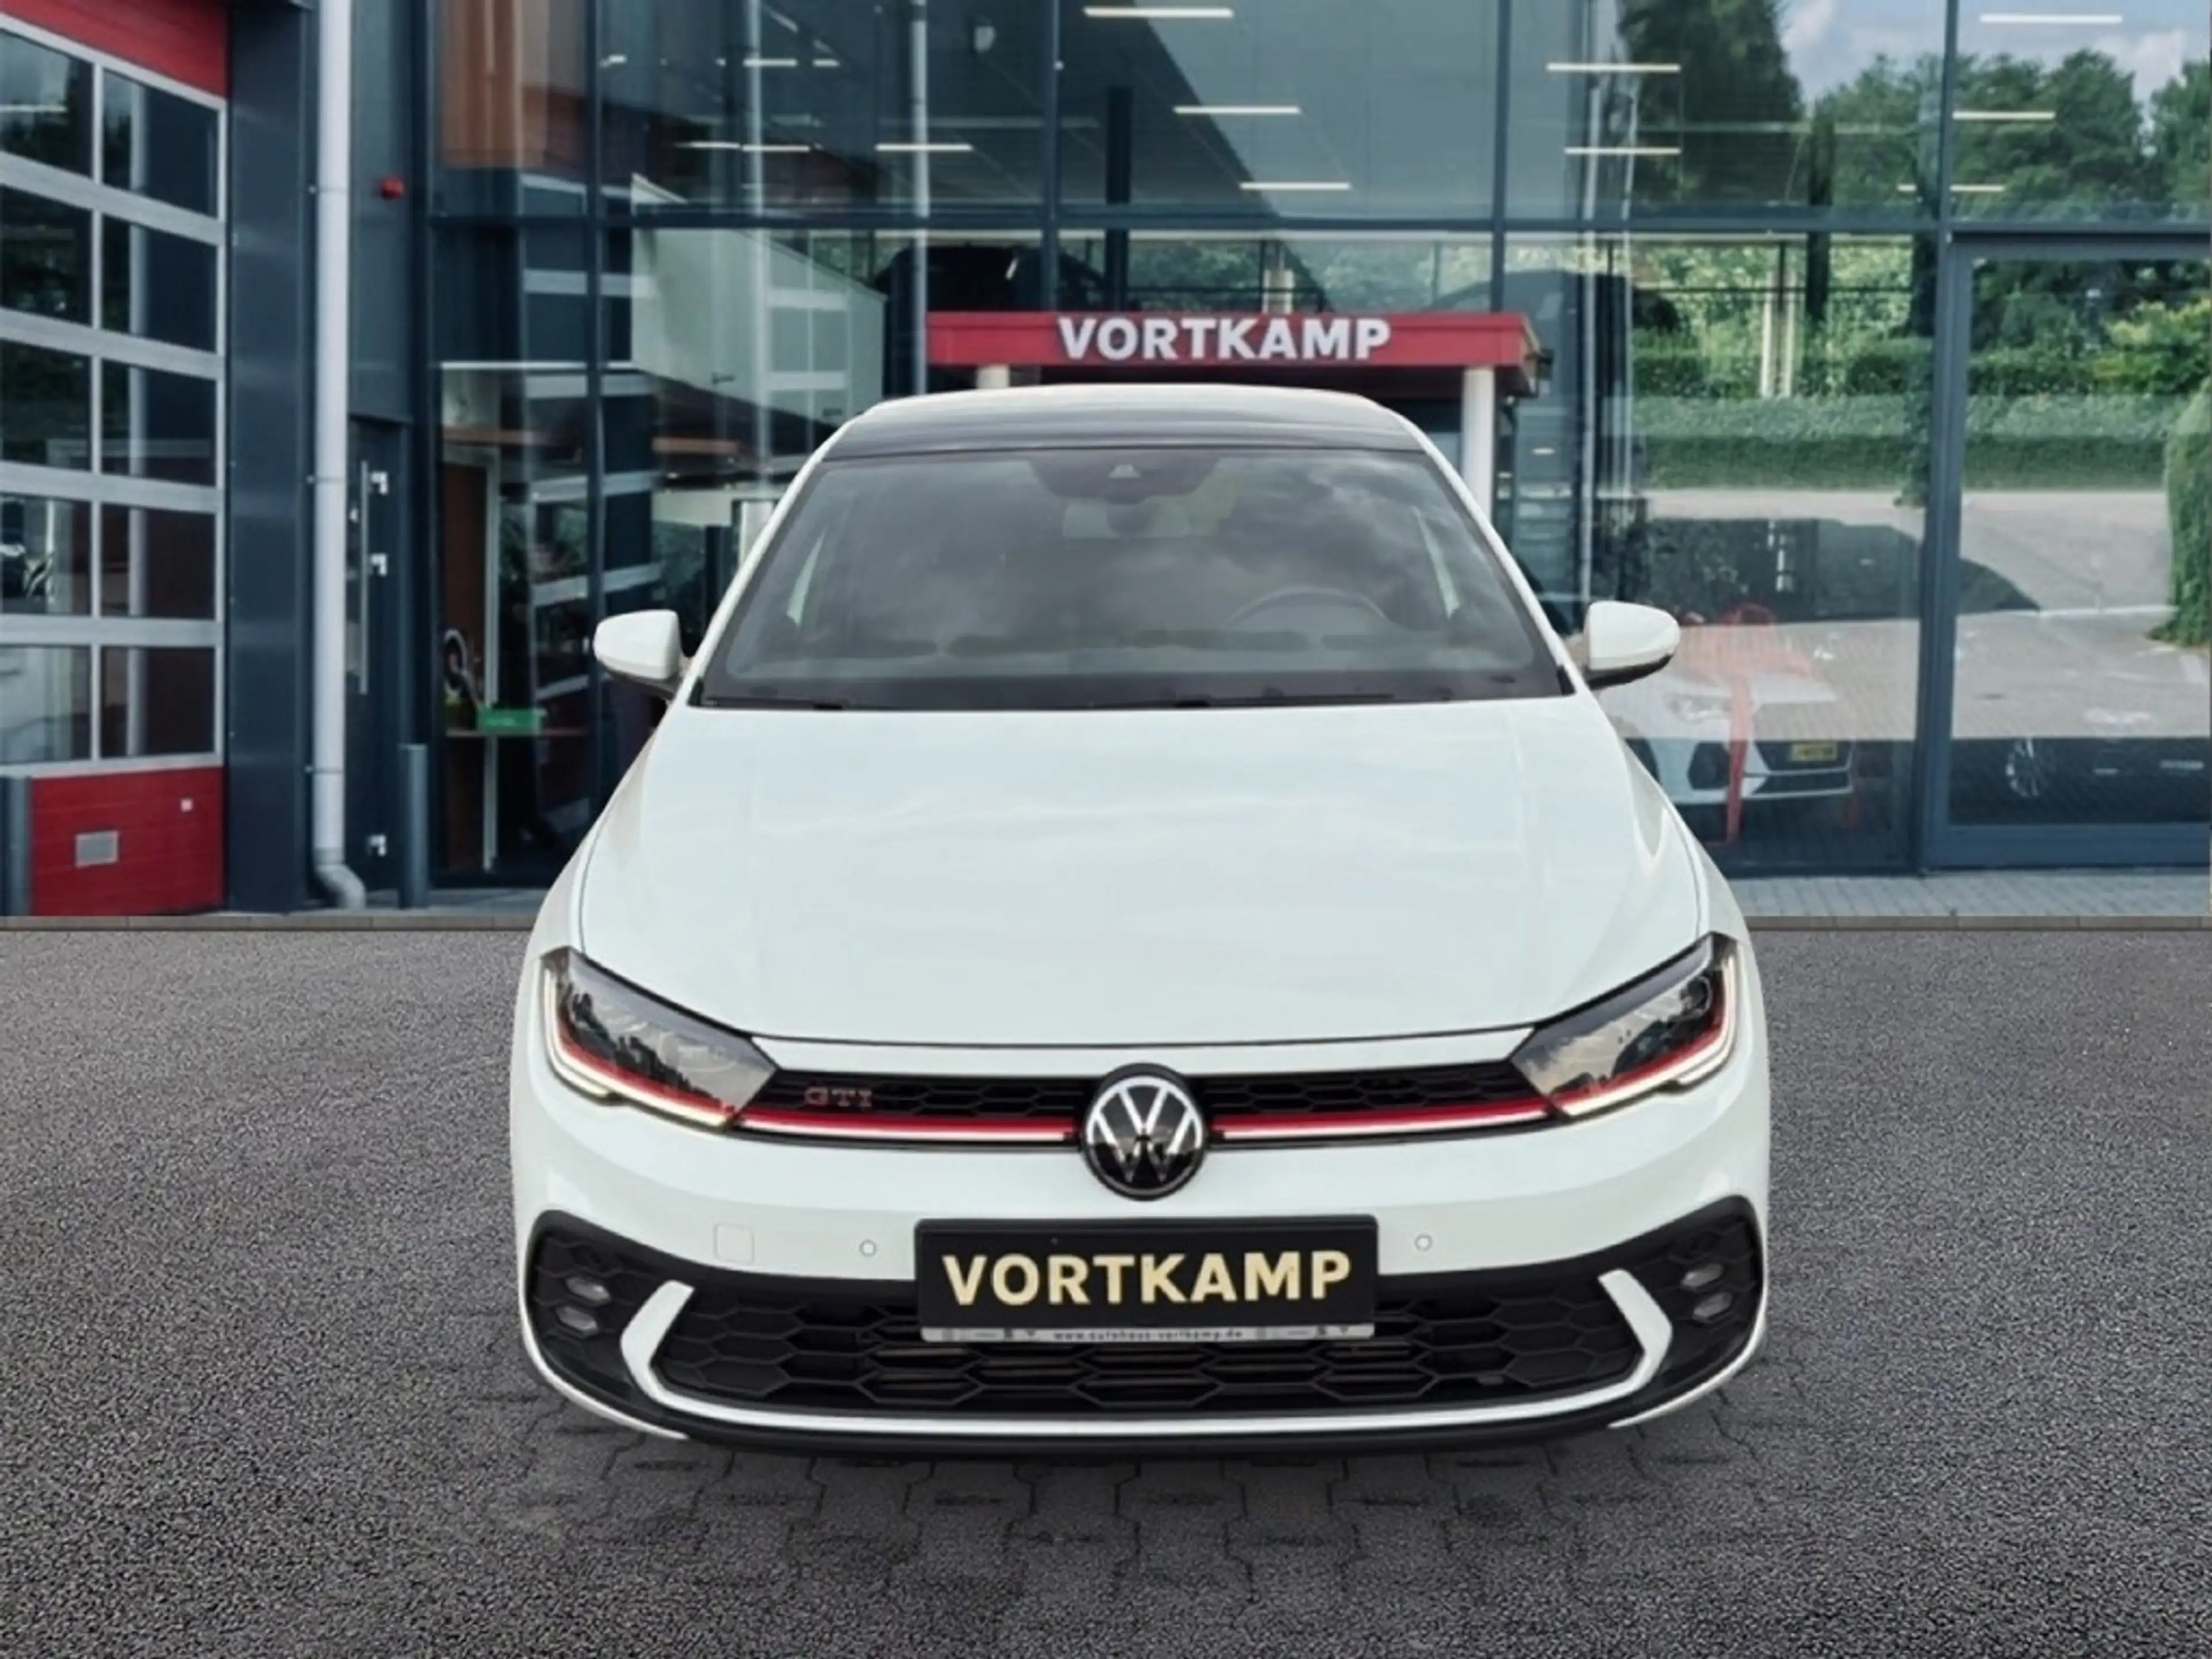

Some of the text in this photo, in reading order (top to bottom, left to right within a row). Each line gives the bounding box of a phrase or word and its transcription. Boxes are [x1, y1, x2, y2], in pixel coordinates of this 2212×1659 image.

[1058, 316, 1392, 361] VORTKAMP
[804, 1086, 873, 1107] GTI
[941, 1249, 1351, 1306] VORTKAMP
